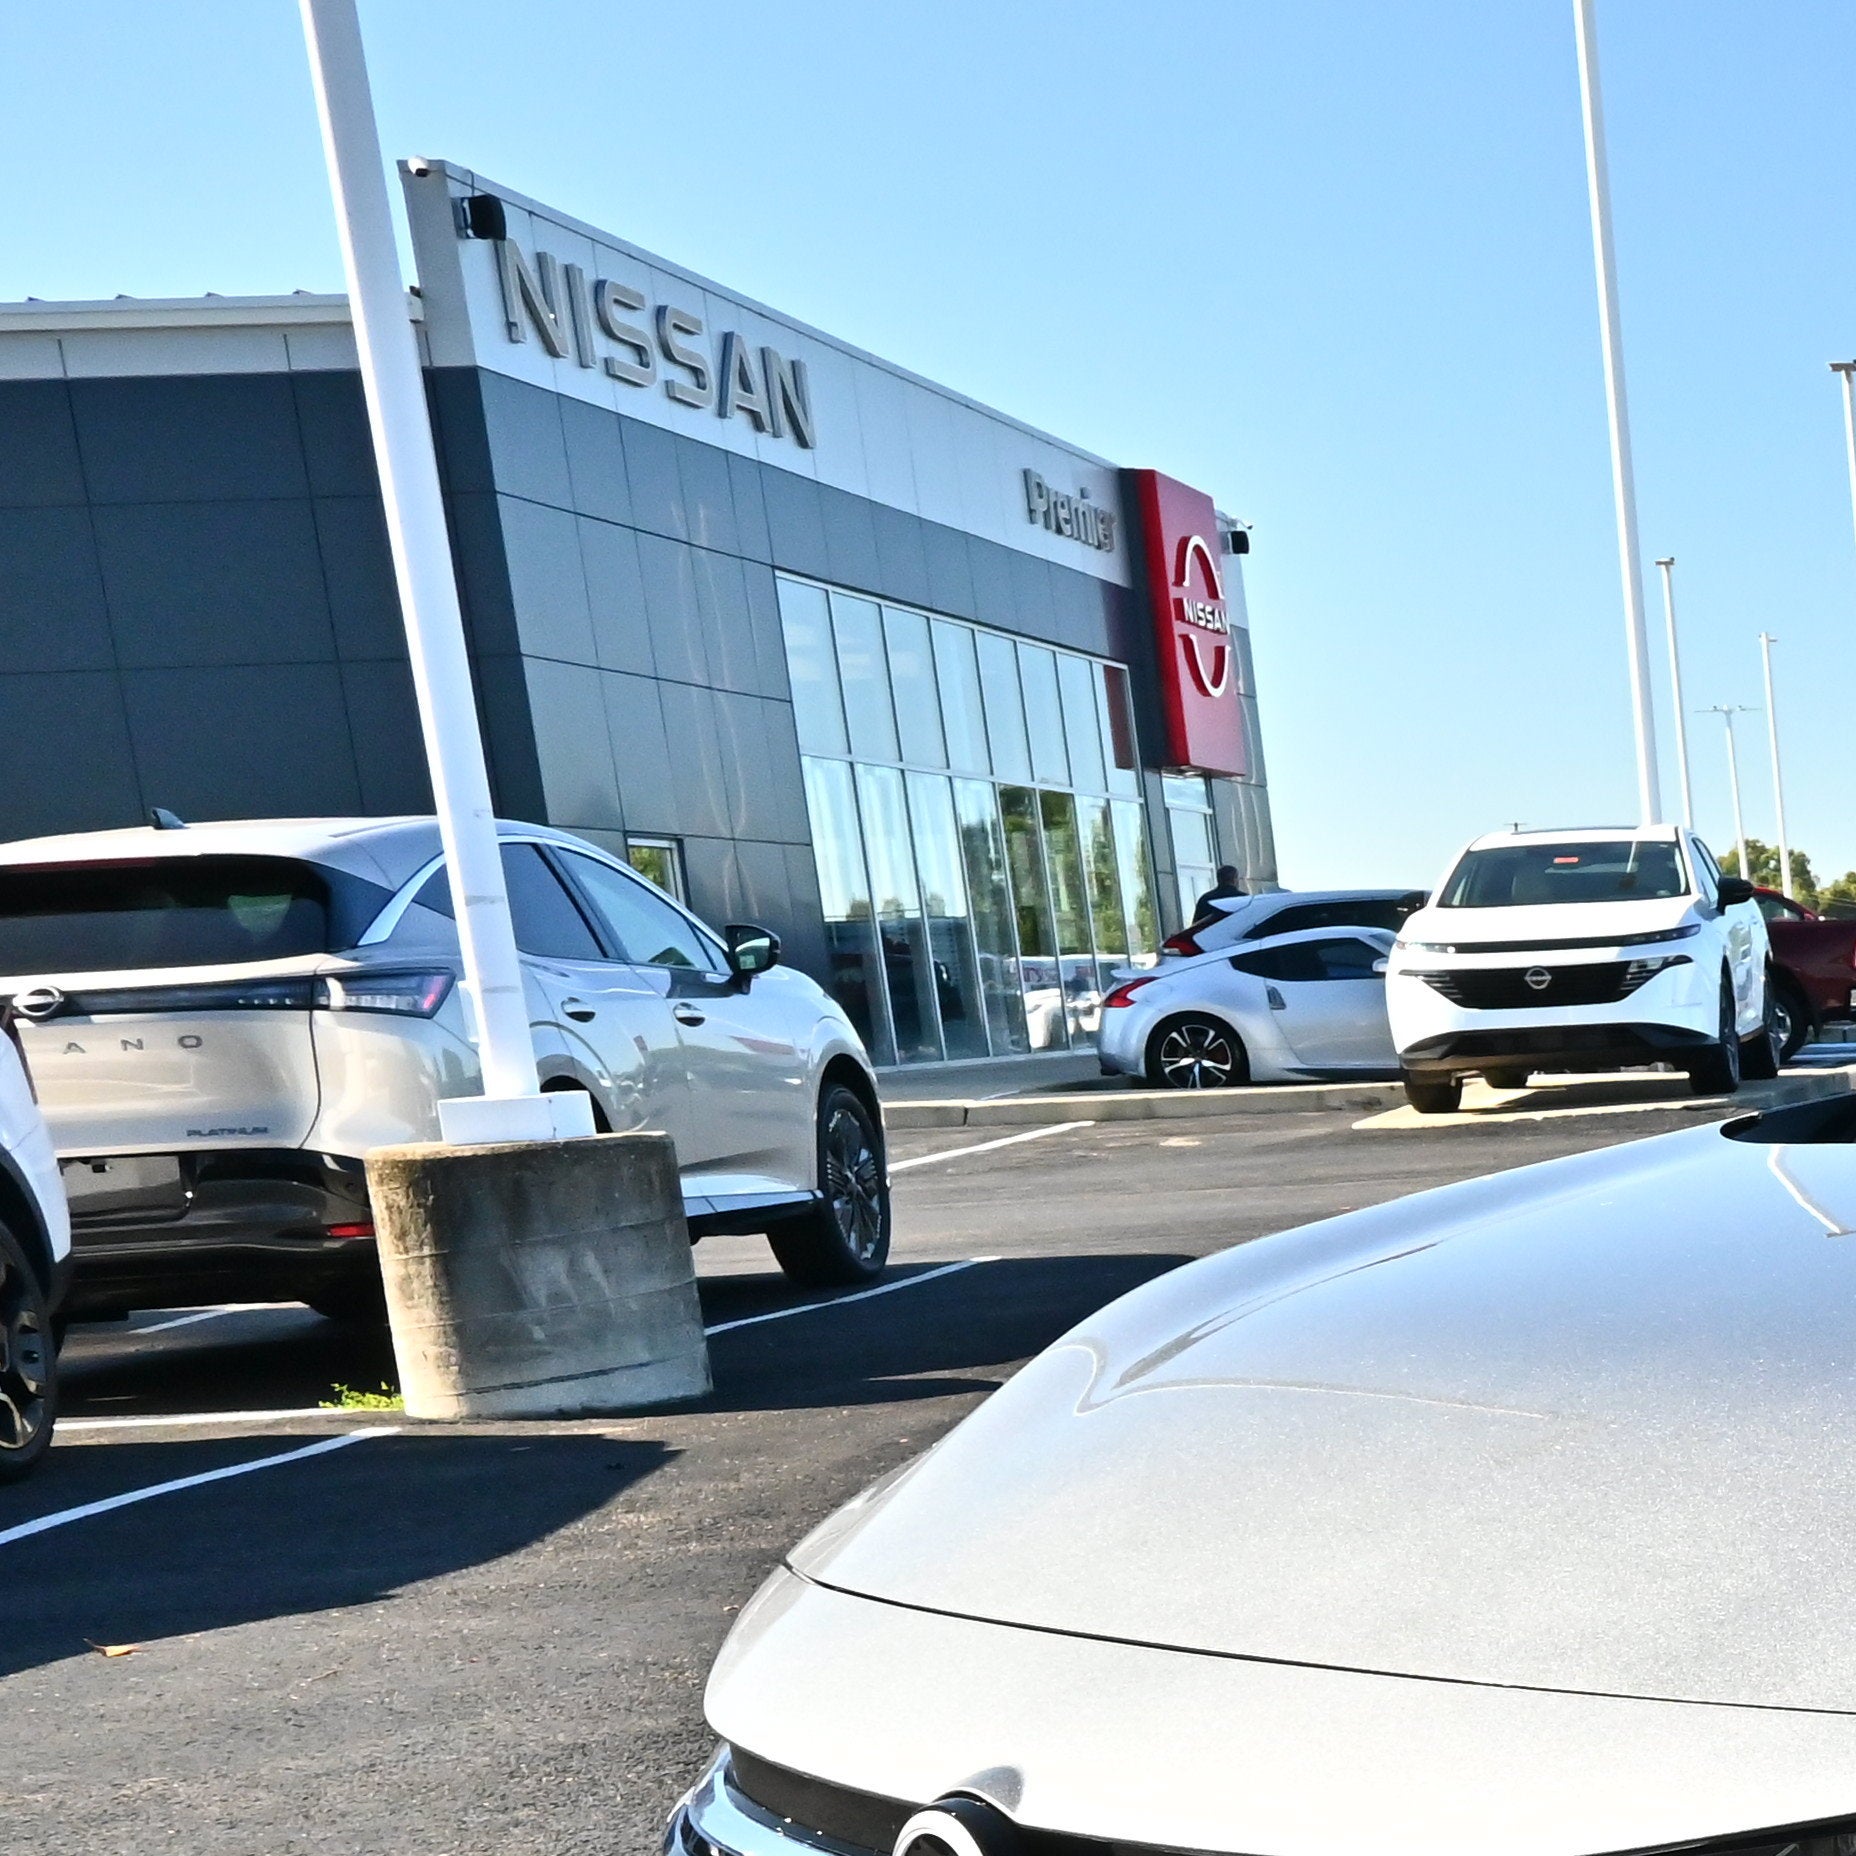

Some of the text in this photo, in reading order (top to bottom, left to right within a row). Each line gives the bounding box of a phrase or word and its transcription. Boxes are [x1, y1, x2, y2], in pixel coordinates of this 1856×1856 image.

[494, 237, 816, 449] NISSAN
[1023, 467, 1117, 553] Premier
[1182, 597, 1231, 635] NISSAN
[62, 1034, 203, 1055] ANO
